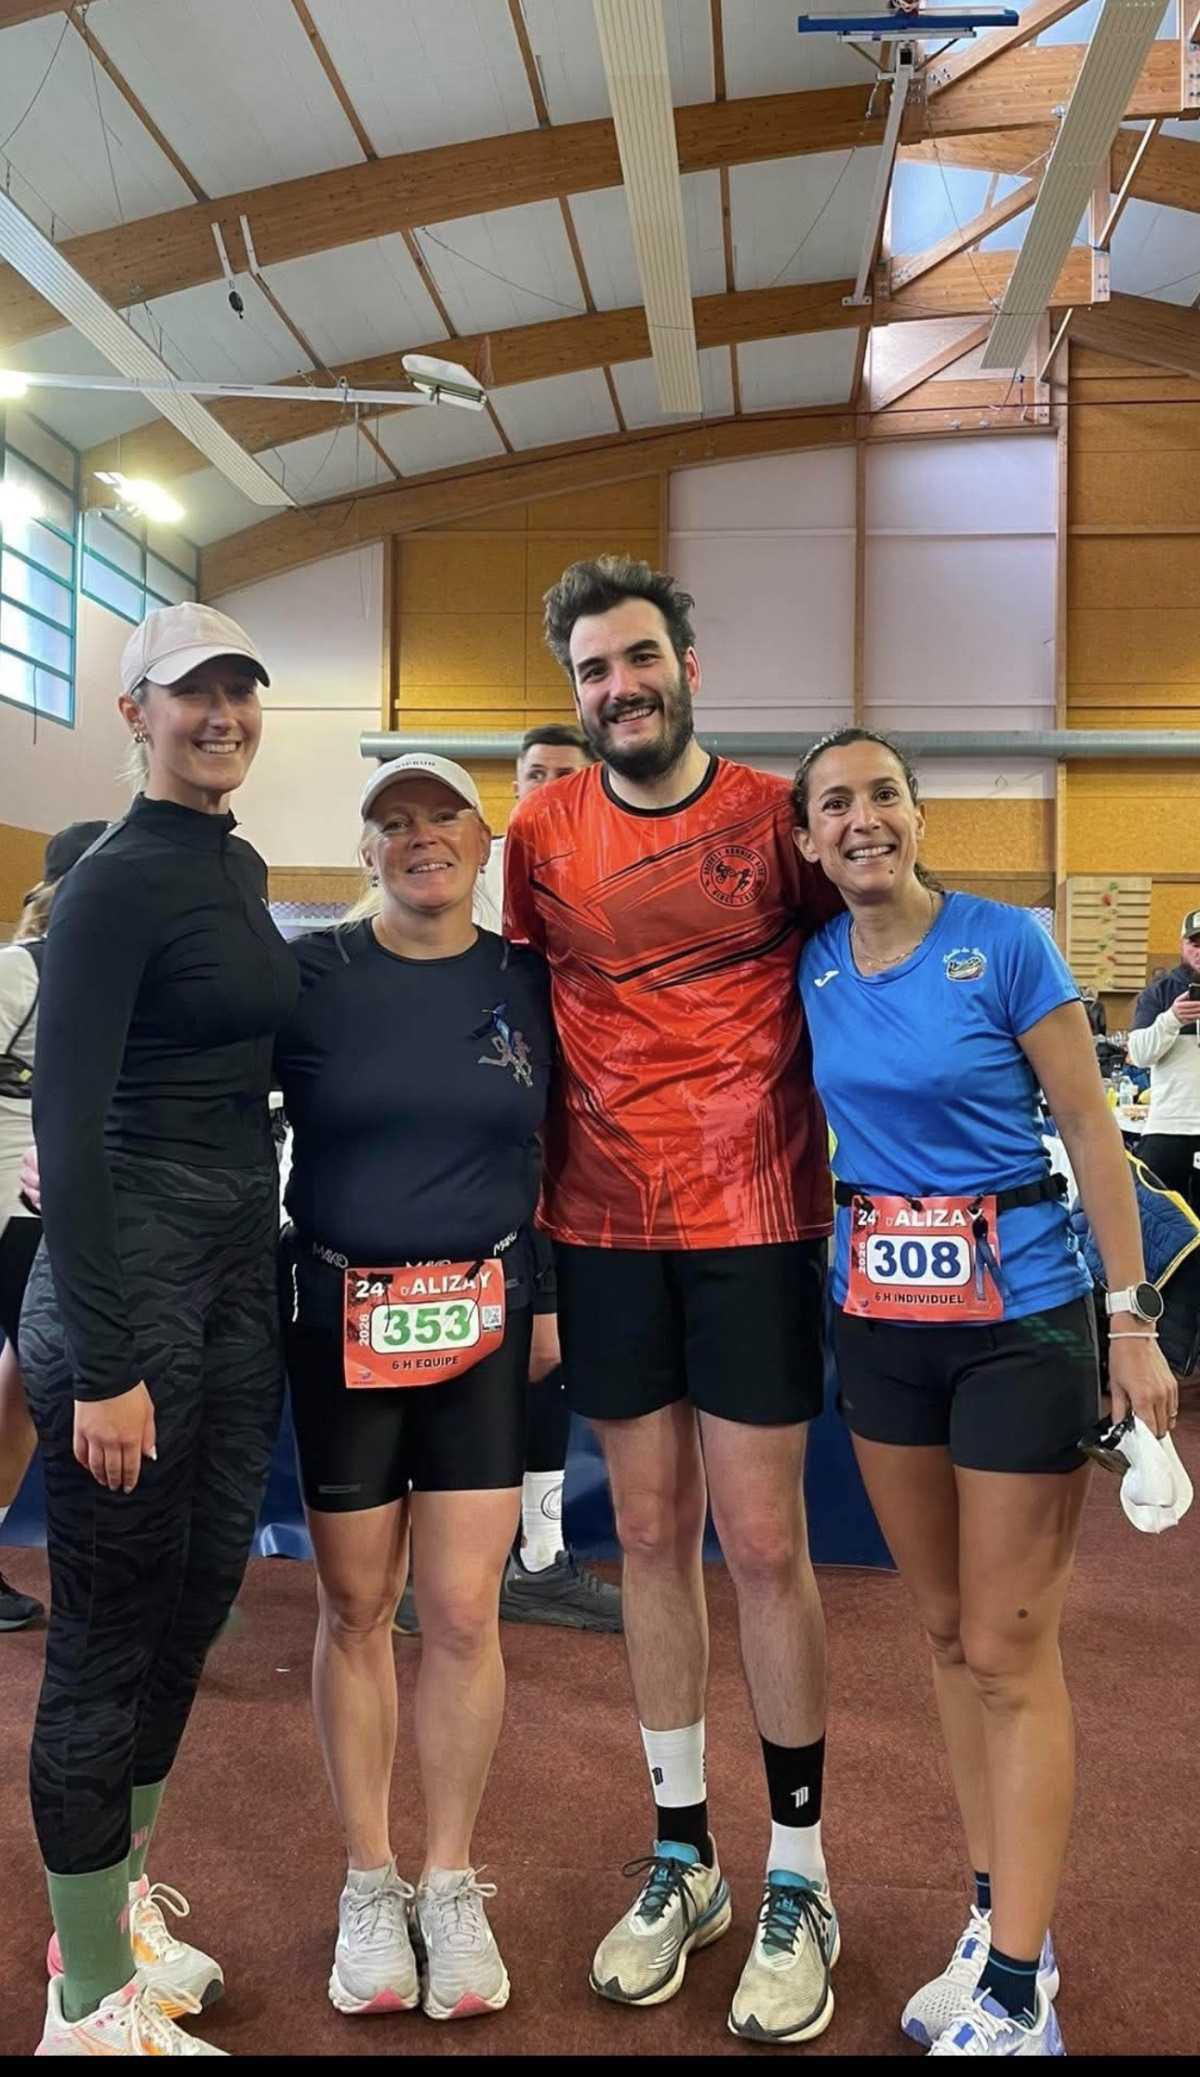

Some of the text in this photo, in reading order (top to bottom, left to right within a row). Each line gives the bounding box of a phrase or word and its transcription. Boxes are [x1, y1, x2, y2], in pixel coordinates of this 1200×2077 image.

[874, 1240, 961, 1279] 308
[875, 1292, 965, 1304] 6 H INDIVIDUEL
[359, 1313, 369, 1346] 2026
[383, 1304, 471, 1346] 353
[391, 1355, 460, 1370] 6 H EQUIPE
